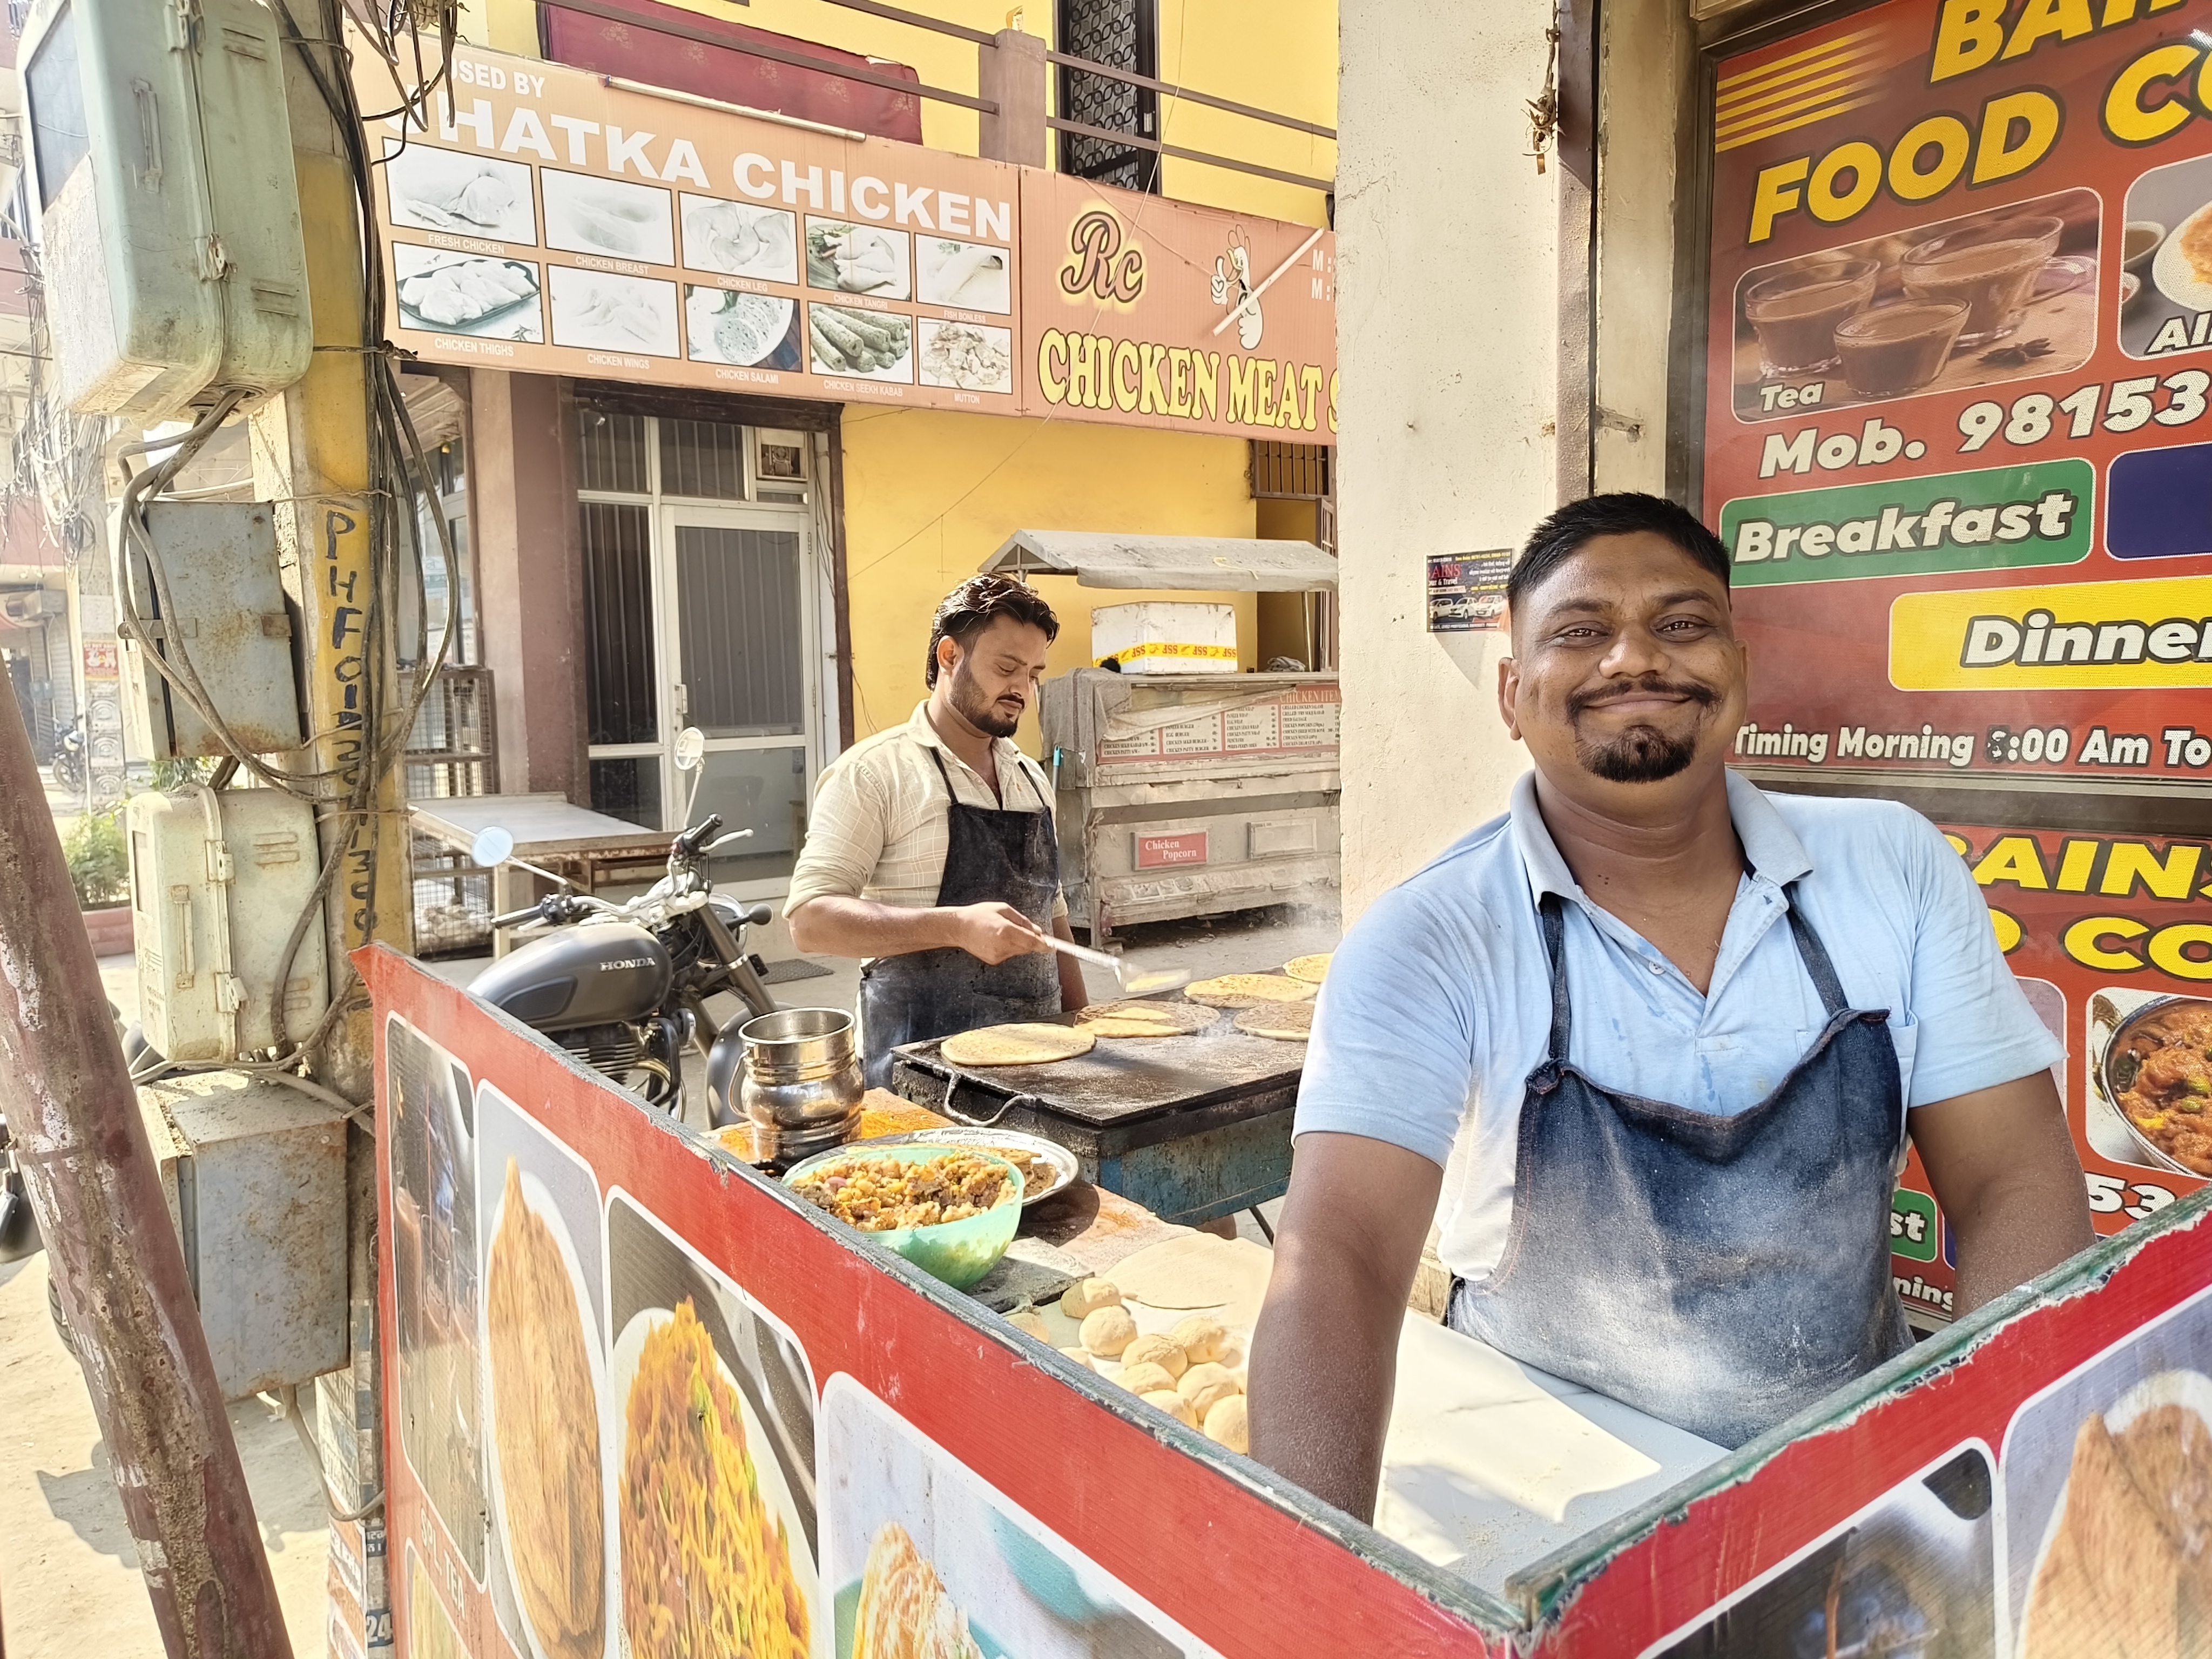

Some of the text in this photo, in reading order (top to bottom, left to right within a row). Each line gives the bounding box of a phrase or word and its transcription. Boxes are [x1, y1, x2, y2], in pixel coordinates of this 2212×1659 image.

[513, 71, 545, 98] BY
[1748, 43, 2212, 245] FOOD C
[380, 83, 1011, 242] JHATKA CHICKEN
[428, 234, 504, 255] FRESH CHICKEN
[575, 255, 649, 275] CHICKEN BREAST
[1060, 211, 1143, 304] Rc
[717, 276, 768, 293] CHICKEN LEG
[833, 293, 888, 310] CHICKEN TANGRI
[943, 309, 987, 324] FISH BONLESS
[434, 337, 514, 357] CHICKEN THIGHS
[587, 353, 650, 370] CHICKEN WINGS
[715, 368, 779, 385] CHICKEN SALAMI
[1037, 327, 1220, 422] CHICKEN
[1226, 354, 1324, 431] MEAT
[823, 380, 903, 397] CHICKEN SEEKH KABAB
[1759, 380, 1824, 413] Tea
[954, 392, 980, 404] MUTTON
[1758, 417, 1927, 480] Mob.
[1734, 493, 2072, 563] Breakfast
[1131, 645, 1145, 658] SSF
[1162, 645, 1178, 654] SSF
[1192, 646, 1208, 656] SSF
[1279, 690, 1319, 703] CHICKEN
[1734, 723, 1829, 763] Timing
[1837, 724, 1975, 767] Morning
[2077, 729, 2150, 765] Am
[2163, 729, 2212, 767] To
[1144, 839, 1180, 852] Chicken
[1162, 847, 1197, 861] Popcorn
[1943, 833, 2212, 899] AIN
[599, 957, 656, 972] HONDA
[443, 1548, 466, 1621] TEA
